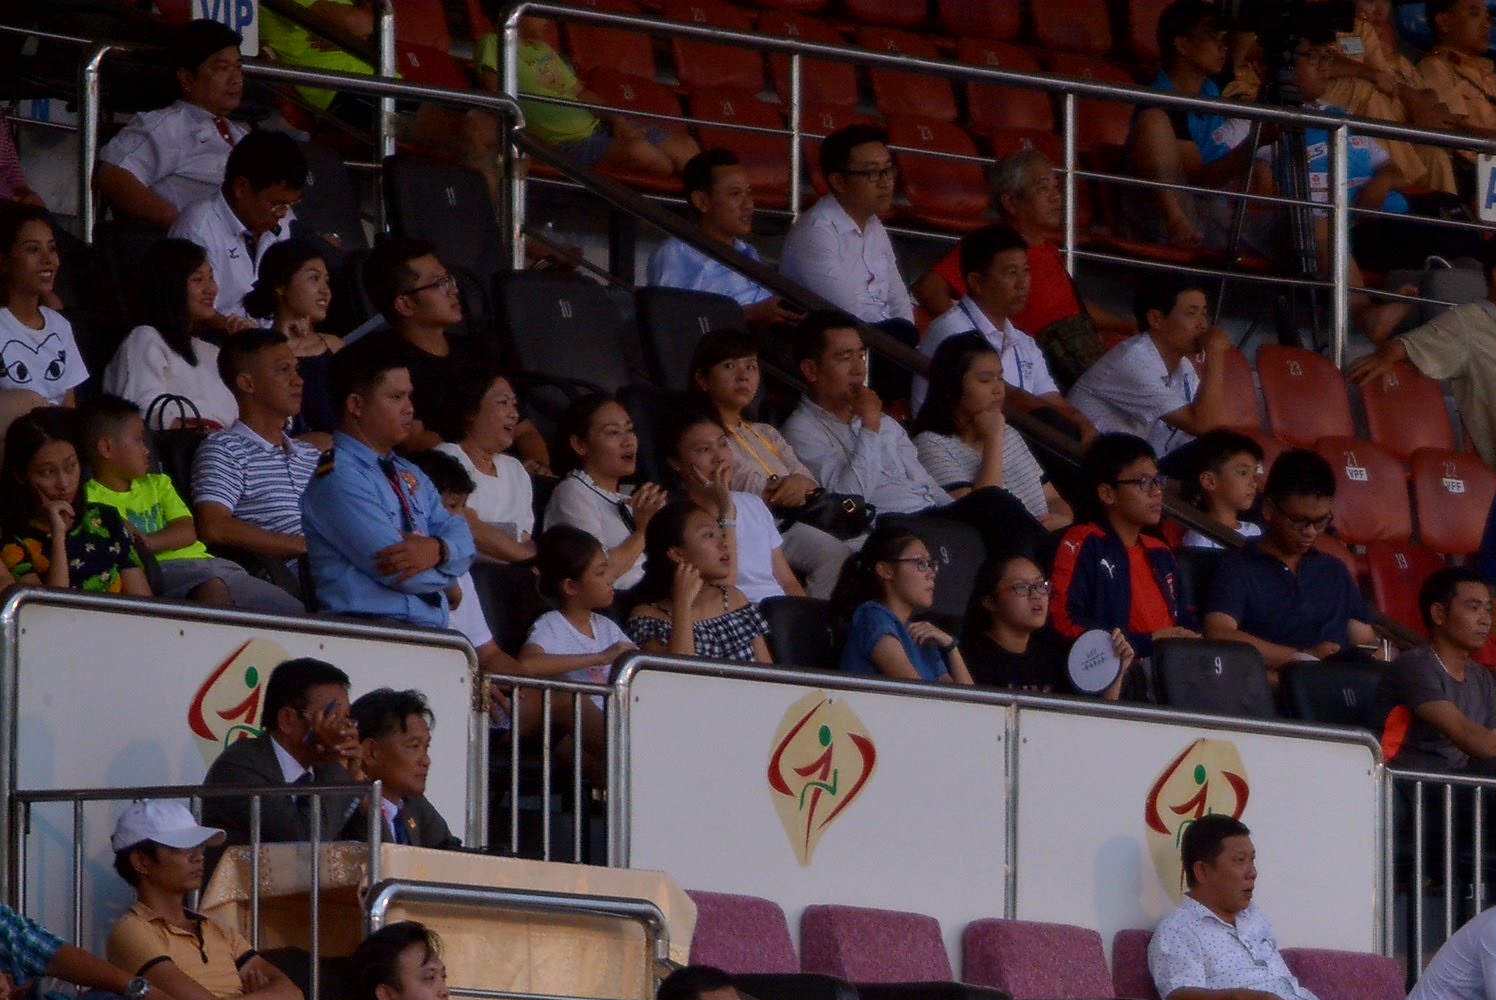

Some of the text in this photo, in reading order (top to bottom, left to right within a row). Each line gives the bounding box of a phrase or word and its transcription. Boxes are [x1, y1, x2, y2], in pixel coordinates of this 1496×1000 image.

[1348, 469, 1364, 479] VPF
[940, 546, 949, 563] 9
[1395, 553, 1408, 569] 19
[1215, 656, 1222, 674] 9
